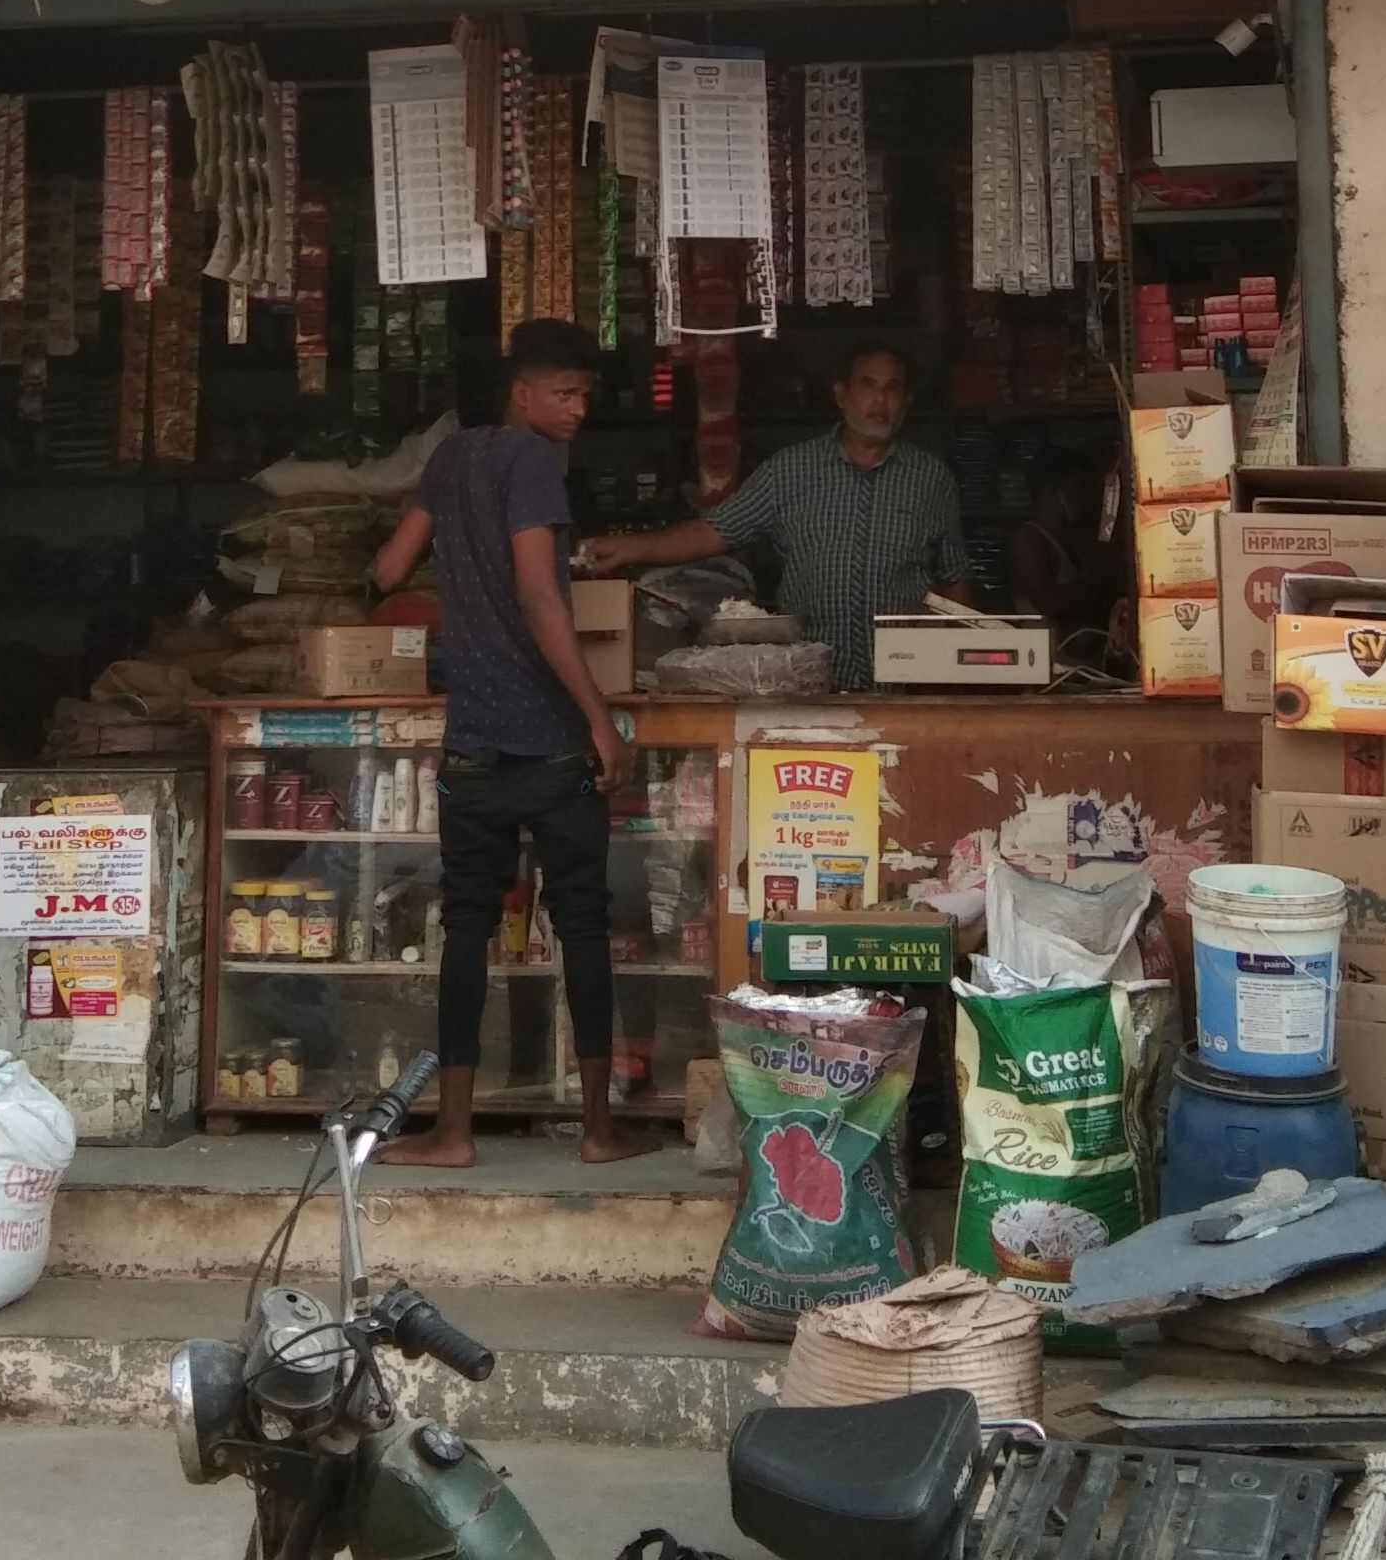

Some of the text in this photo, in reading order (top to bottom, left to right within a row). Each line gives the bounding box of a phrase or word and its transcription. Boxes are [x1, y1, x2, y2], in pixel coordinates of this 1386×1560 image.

[1247, 536, 1328, 552] HPMP2R3
[1352, 633, 1385, 659] SV
[779, 765, 847, 791] FREE
[2, 826, 31, 839] பல்
[776, 827, 813, 848] 1 kg
[19, 839, 123, 851] Full Stop
[35, 895, 108, 918] J.M
[889, 942, 941, 955] DATES
[1026, 1044, 1106, 1079] Great
[984, 1127, 1058, 1170] Rice
